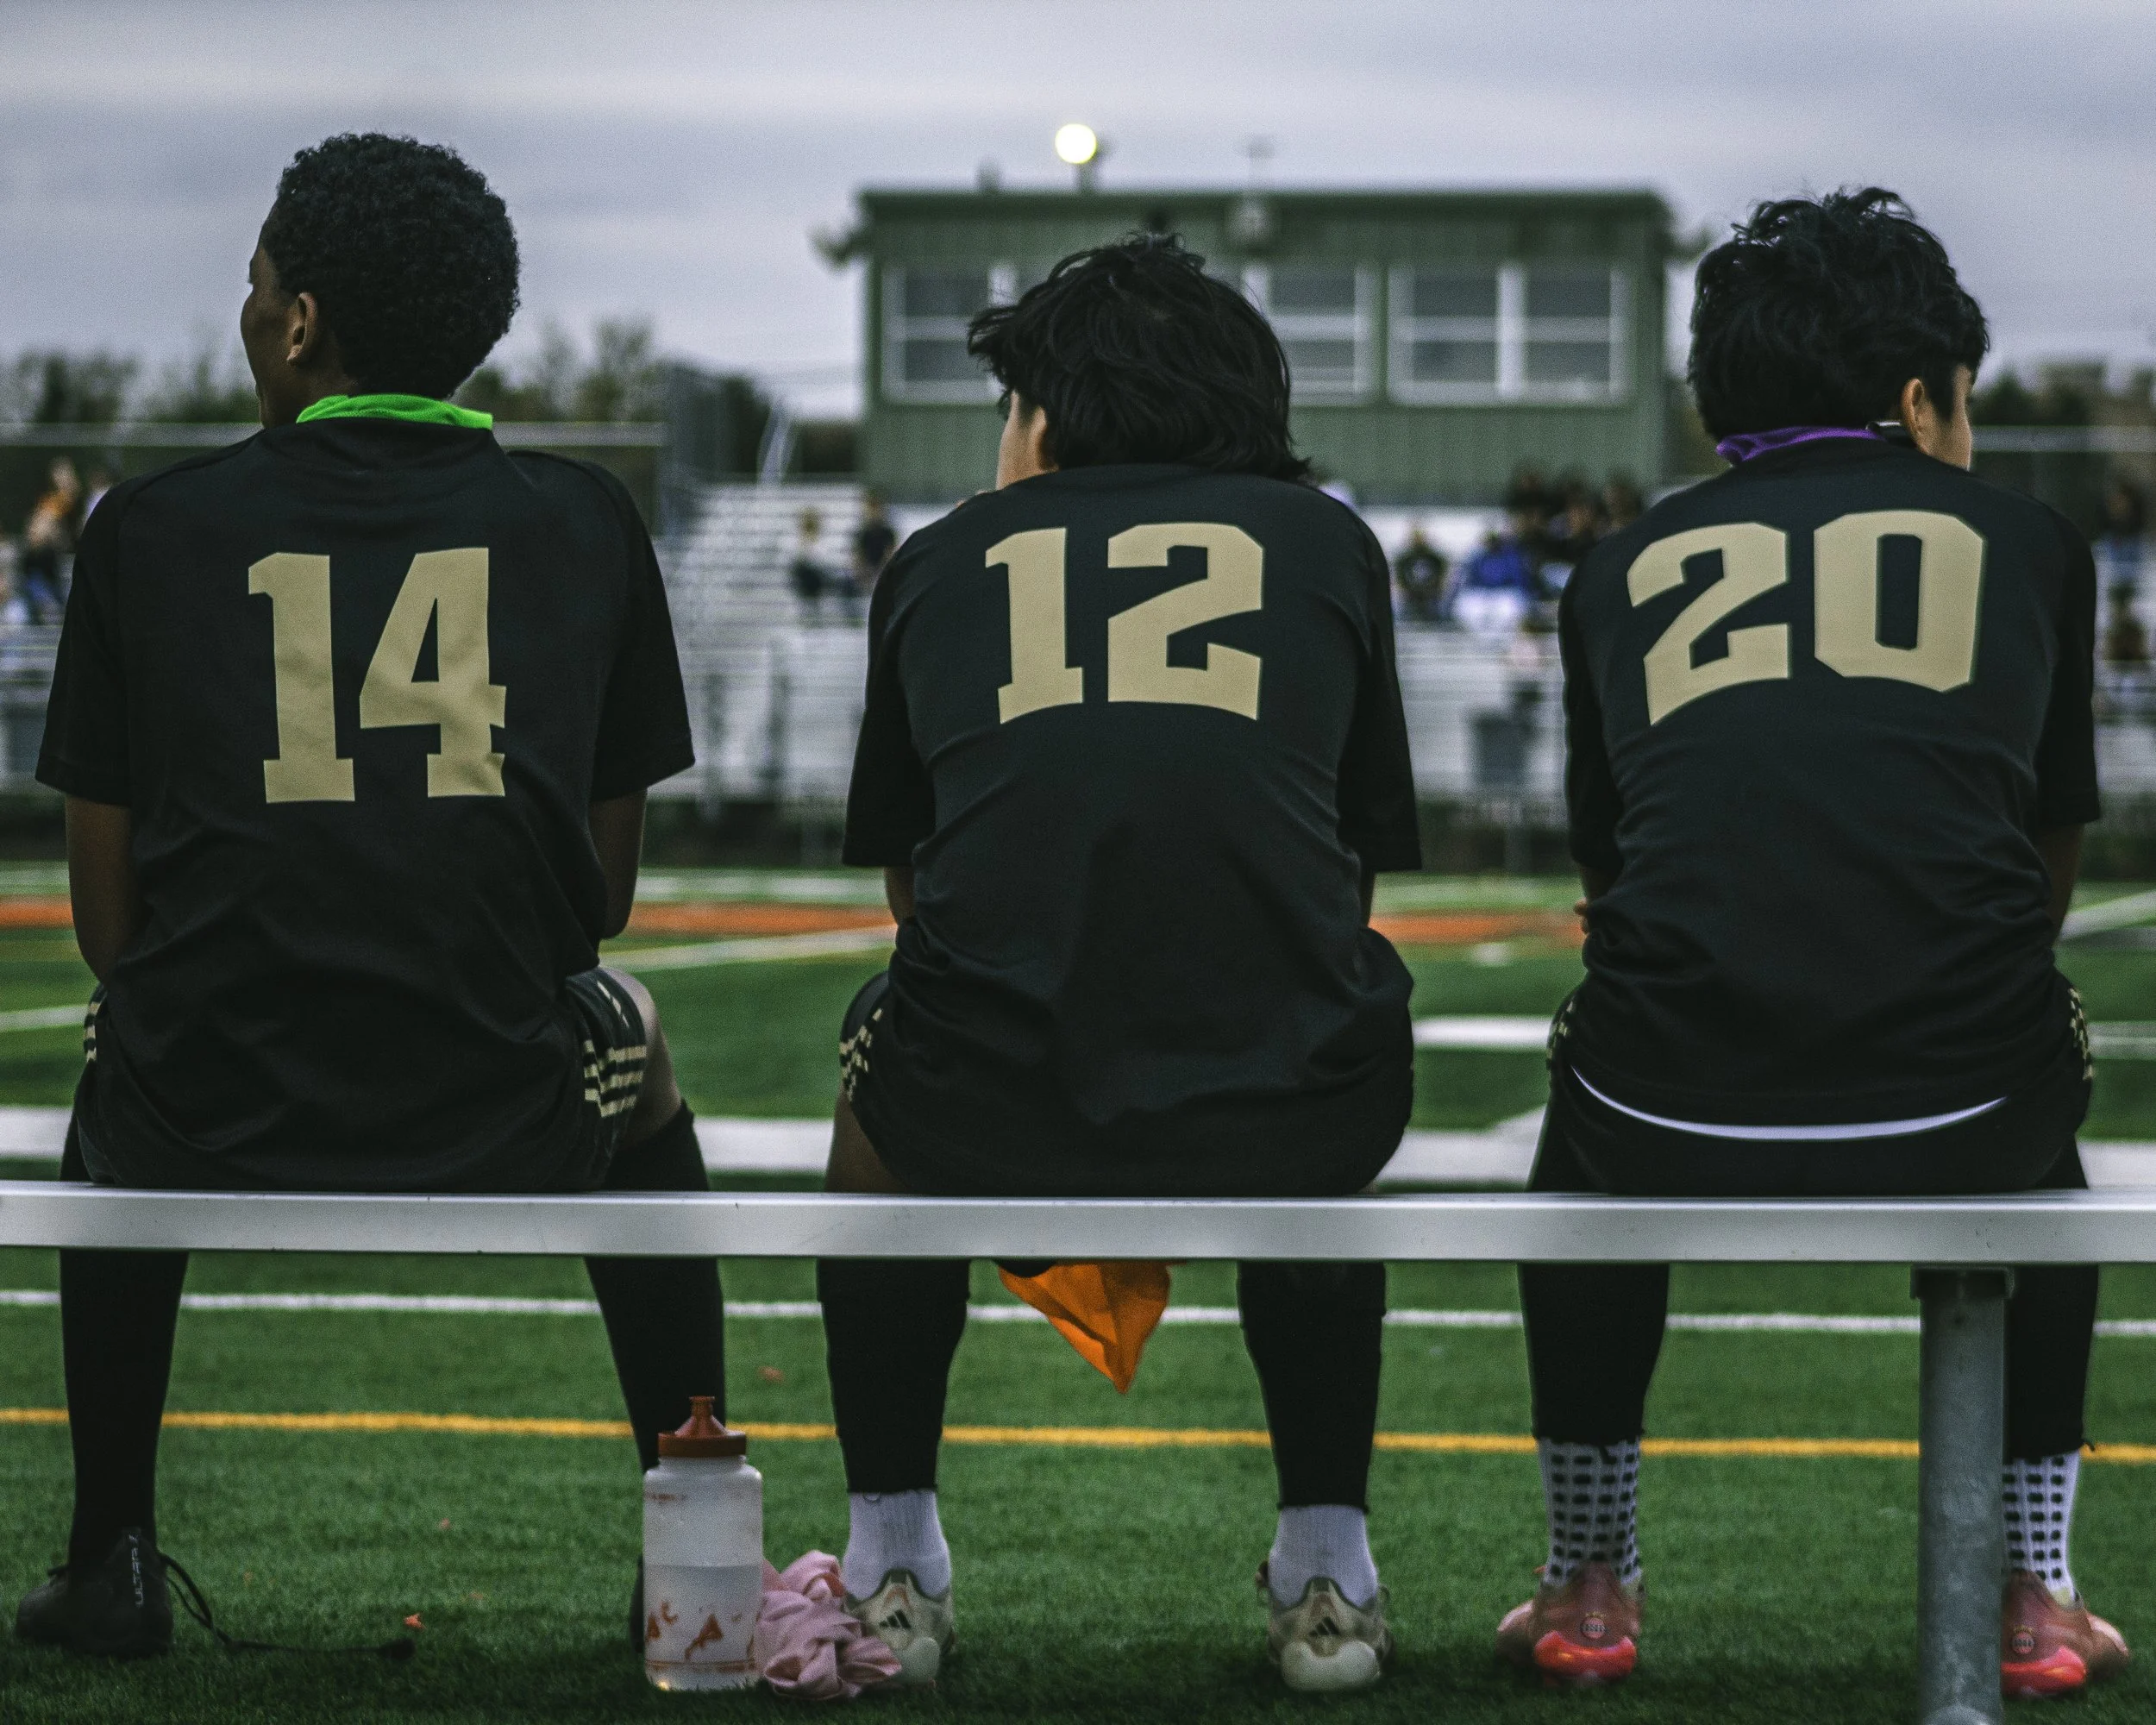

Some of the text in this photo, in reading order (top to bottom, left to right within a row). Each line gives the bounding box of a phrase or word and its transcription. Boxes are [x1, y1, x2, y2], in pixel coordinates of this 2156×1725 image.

[248, 546, 507, 803] 14
[985, 522, 1264, 724] 12
[1626, 509, 1985, 726] 20
